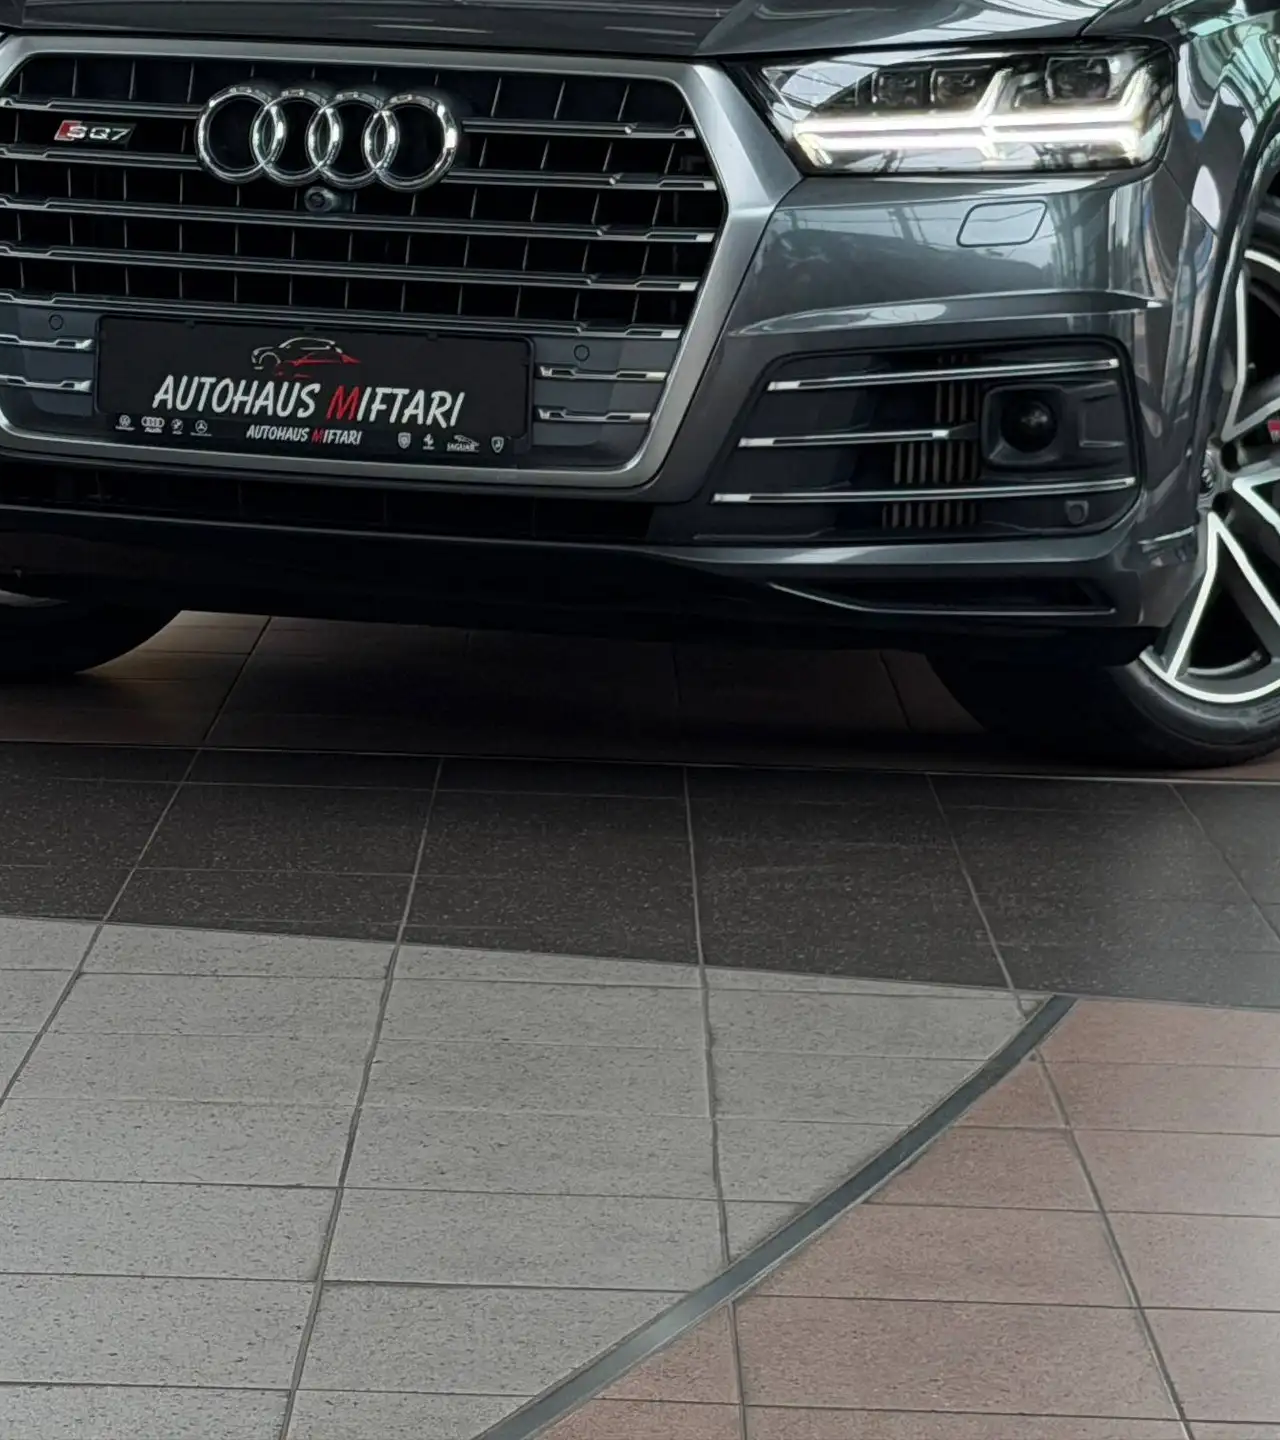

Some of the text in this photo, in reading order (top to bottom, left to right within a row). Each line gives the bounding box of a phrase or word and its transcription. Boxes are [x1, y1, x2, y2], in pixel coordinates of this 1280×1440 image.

[65, 123, 132, 141] SQ7
[152, 374, 466, 429] AUTOHAUS MIFTARI
[245, 423, 362, 446] AUTOHAUS MIFTARI
